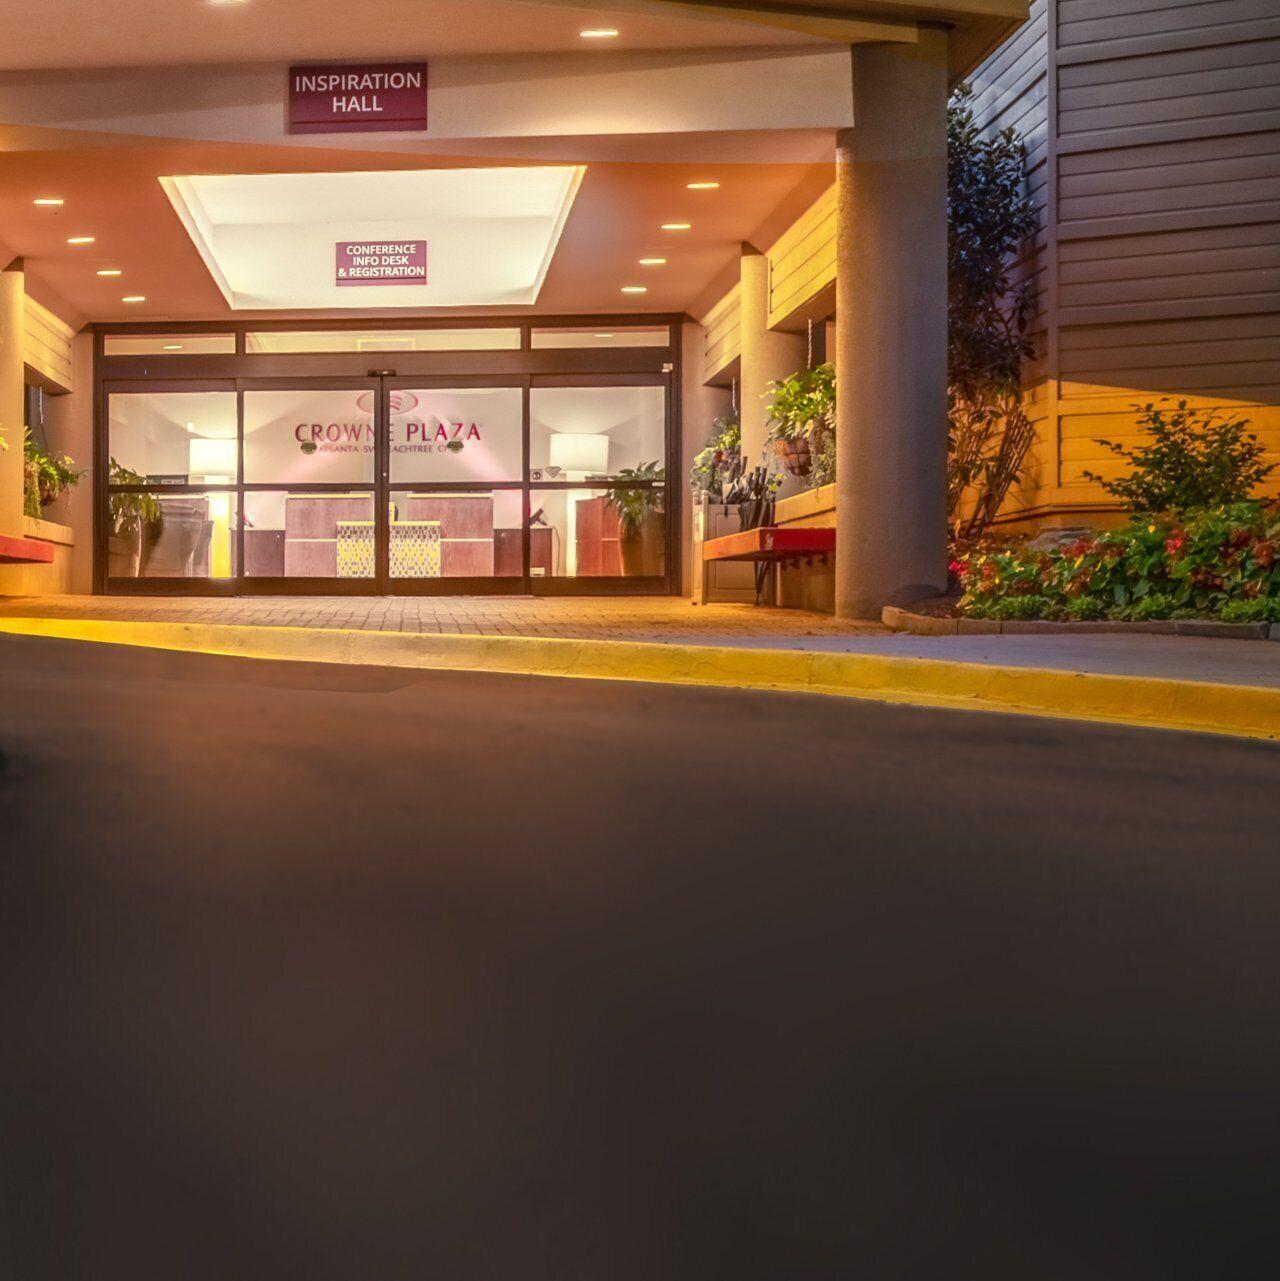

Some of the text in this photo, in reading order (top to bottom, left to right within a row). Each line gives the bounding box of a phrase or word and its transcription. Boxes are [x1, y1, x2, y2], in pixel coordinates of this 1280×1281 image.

[295, 72, 421, 92] INSPIRATION
[332, 95, 383, 113] HALL
[346, 244, 417, 255] CONFERENCE
[353, 255, 409, 266] INFO DESK
[338, 266, 425, 277] & REGISTRATION
[406, 422, 481, 441] PLAZA
